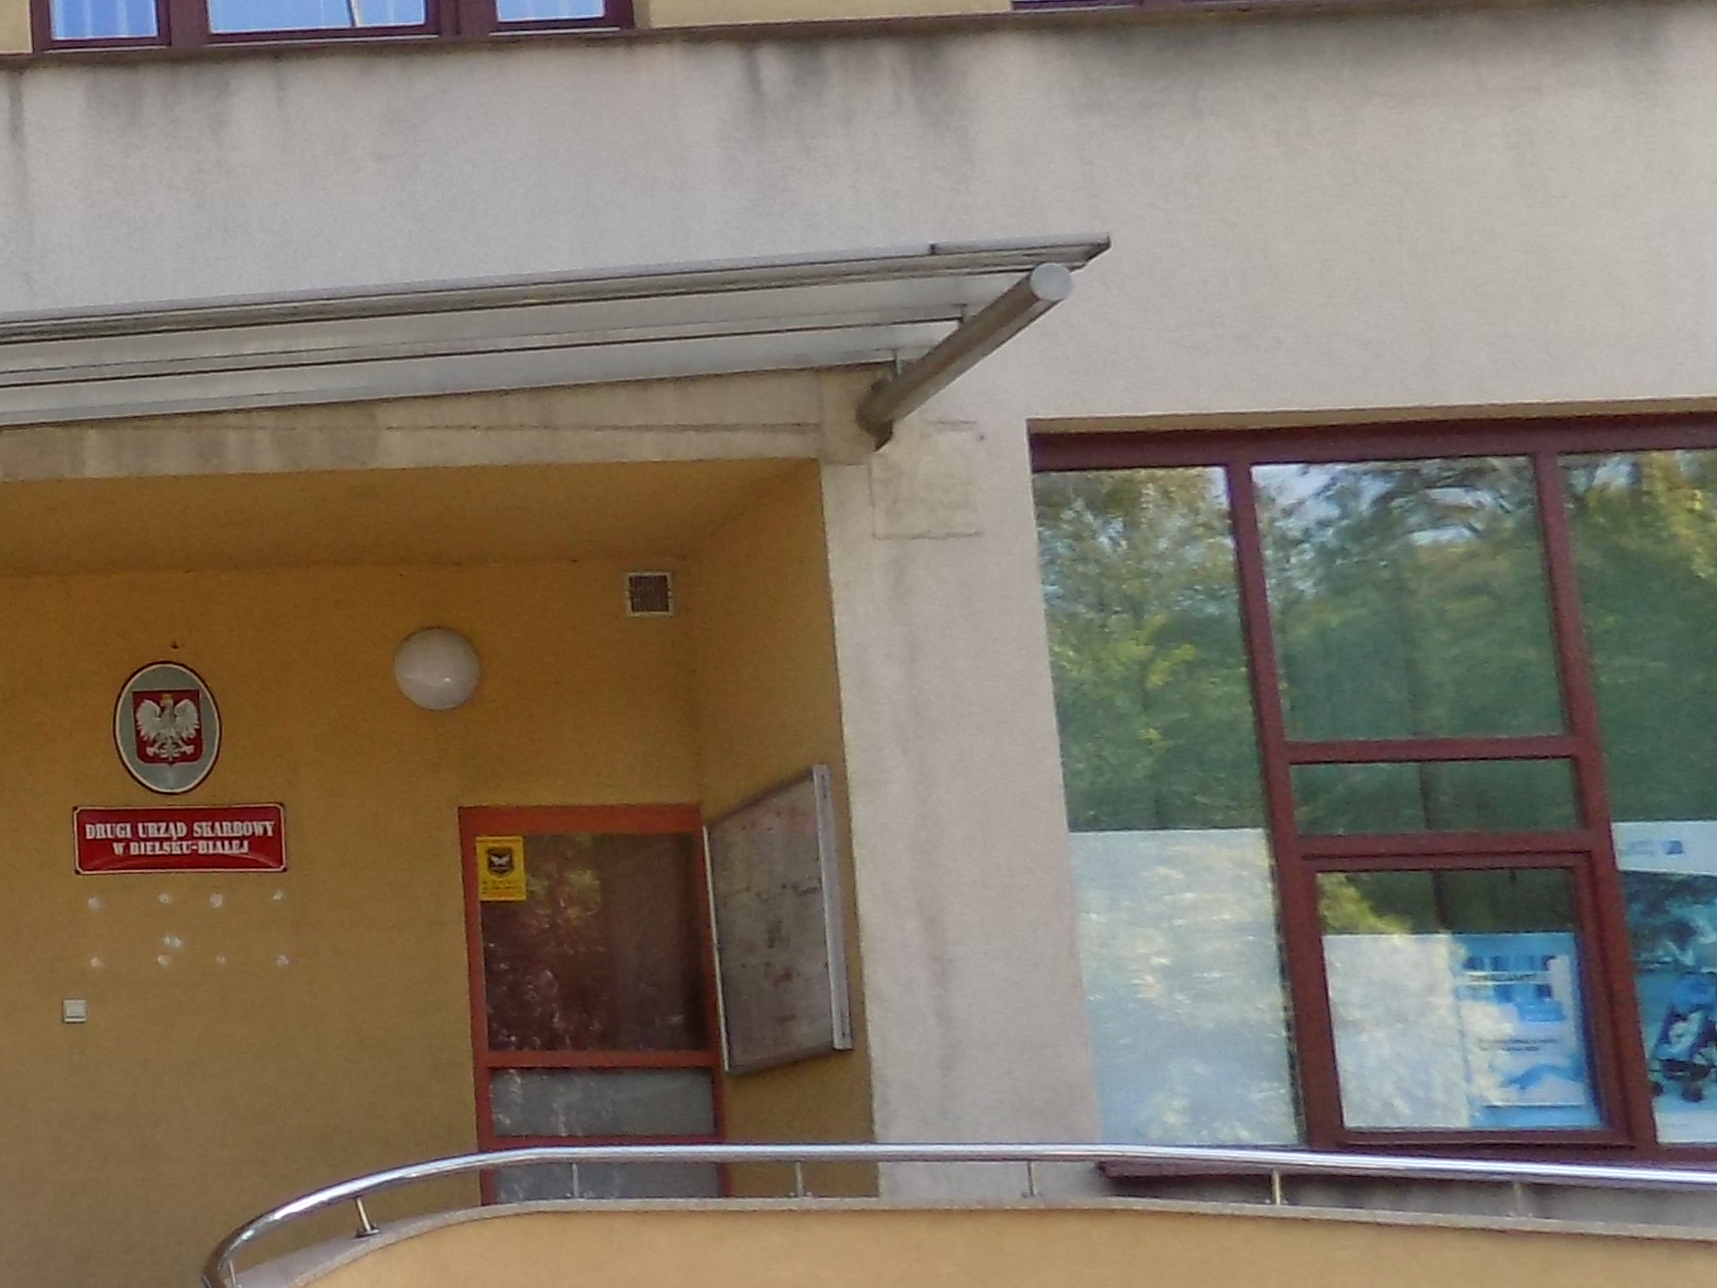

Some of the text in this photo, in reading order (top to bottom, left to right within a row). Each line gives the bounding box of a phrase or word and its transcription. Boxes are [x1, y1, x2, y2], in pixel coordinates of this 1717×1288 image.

[85, 820, 275, 840] DRUGI URZĄD SKARBOWY
[112, 842, 126, 855] W
